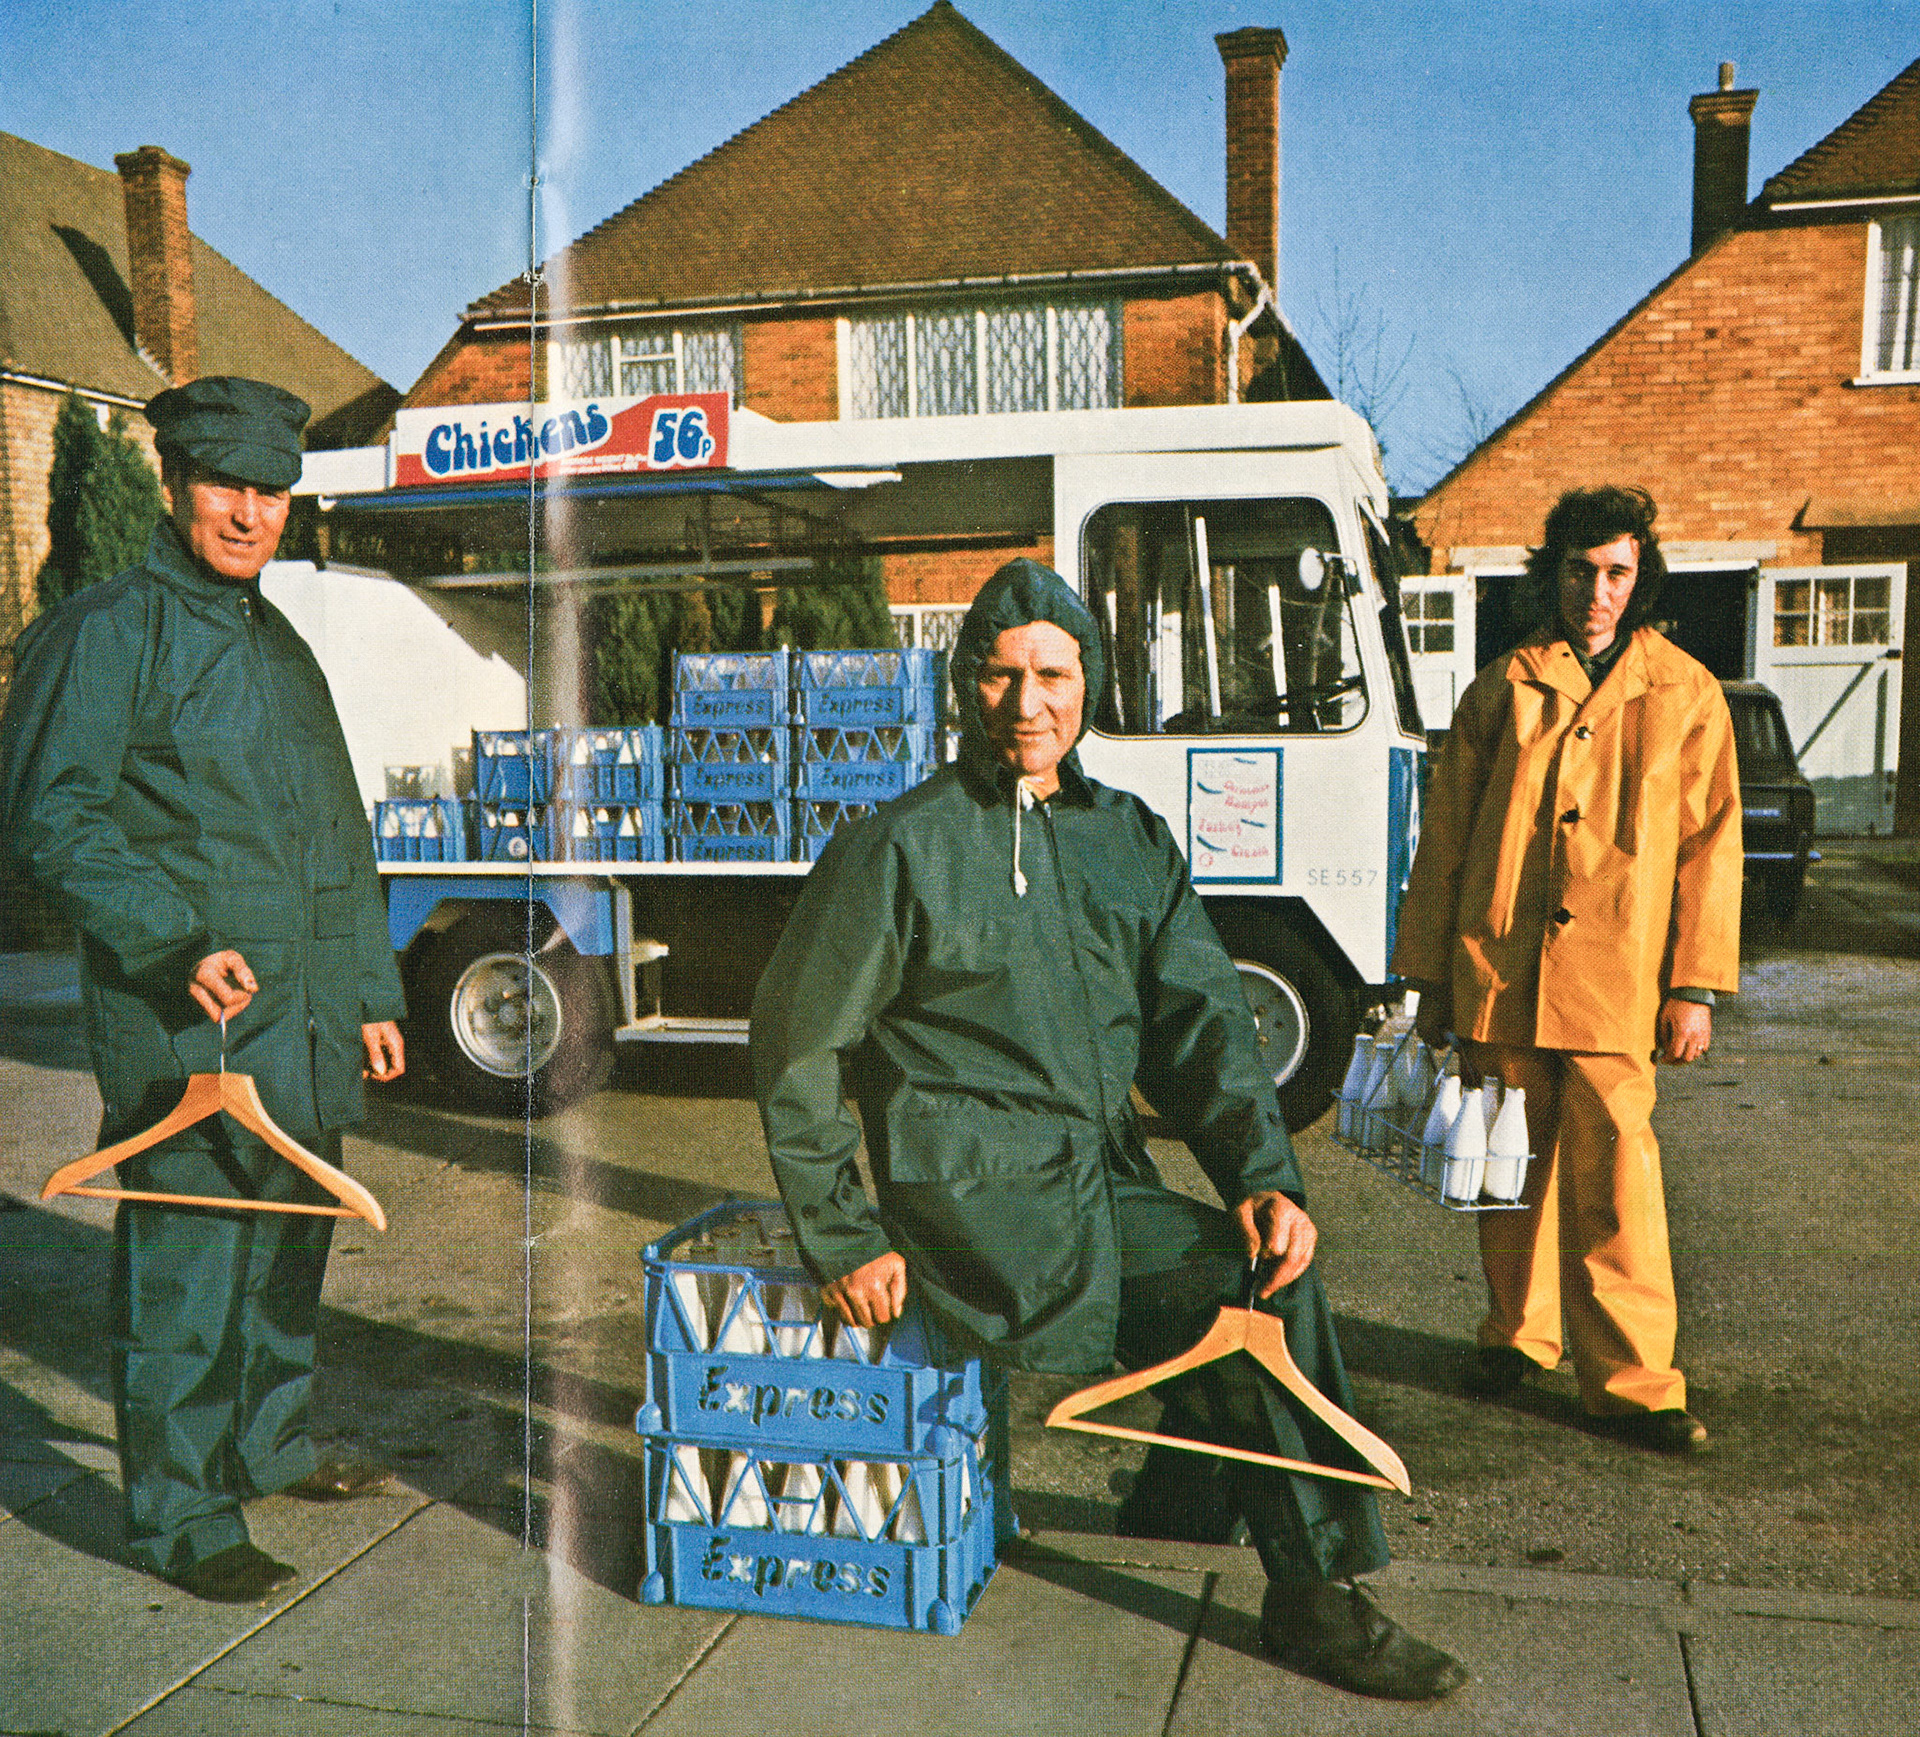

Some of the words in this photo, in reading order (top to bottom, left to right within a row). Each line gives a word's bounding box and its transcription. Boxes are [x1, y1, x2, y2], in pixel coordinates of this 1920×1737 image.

[426, 403, 608, 475] Chickens
[694, 694, 765, 719] Express
[819, 693, 895, 717] Express
[695, 767, 766, 787] Express
[821, 767, 897, 787] Express
[698, 1365, 890, 1427] Express
[701, 1536, 891, 1598] Express
